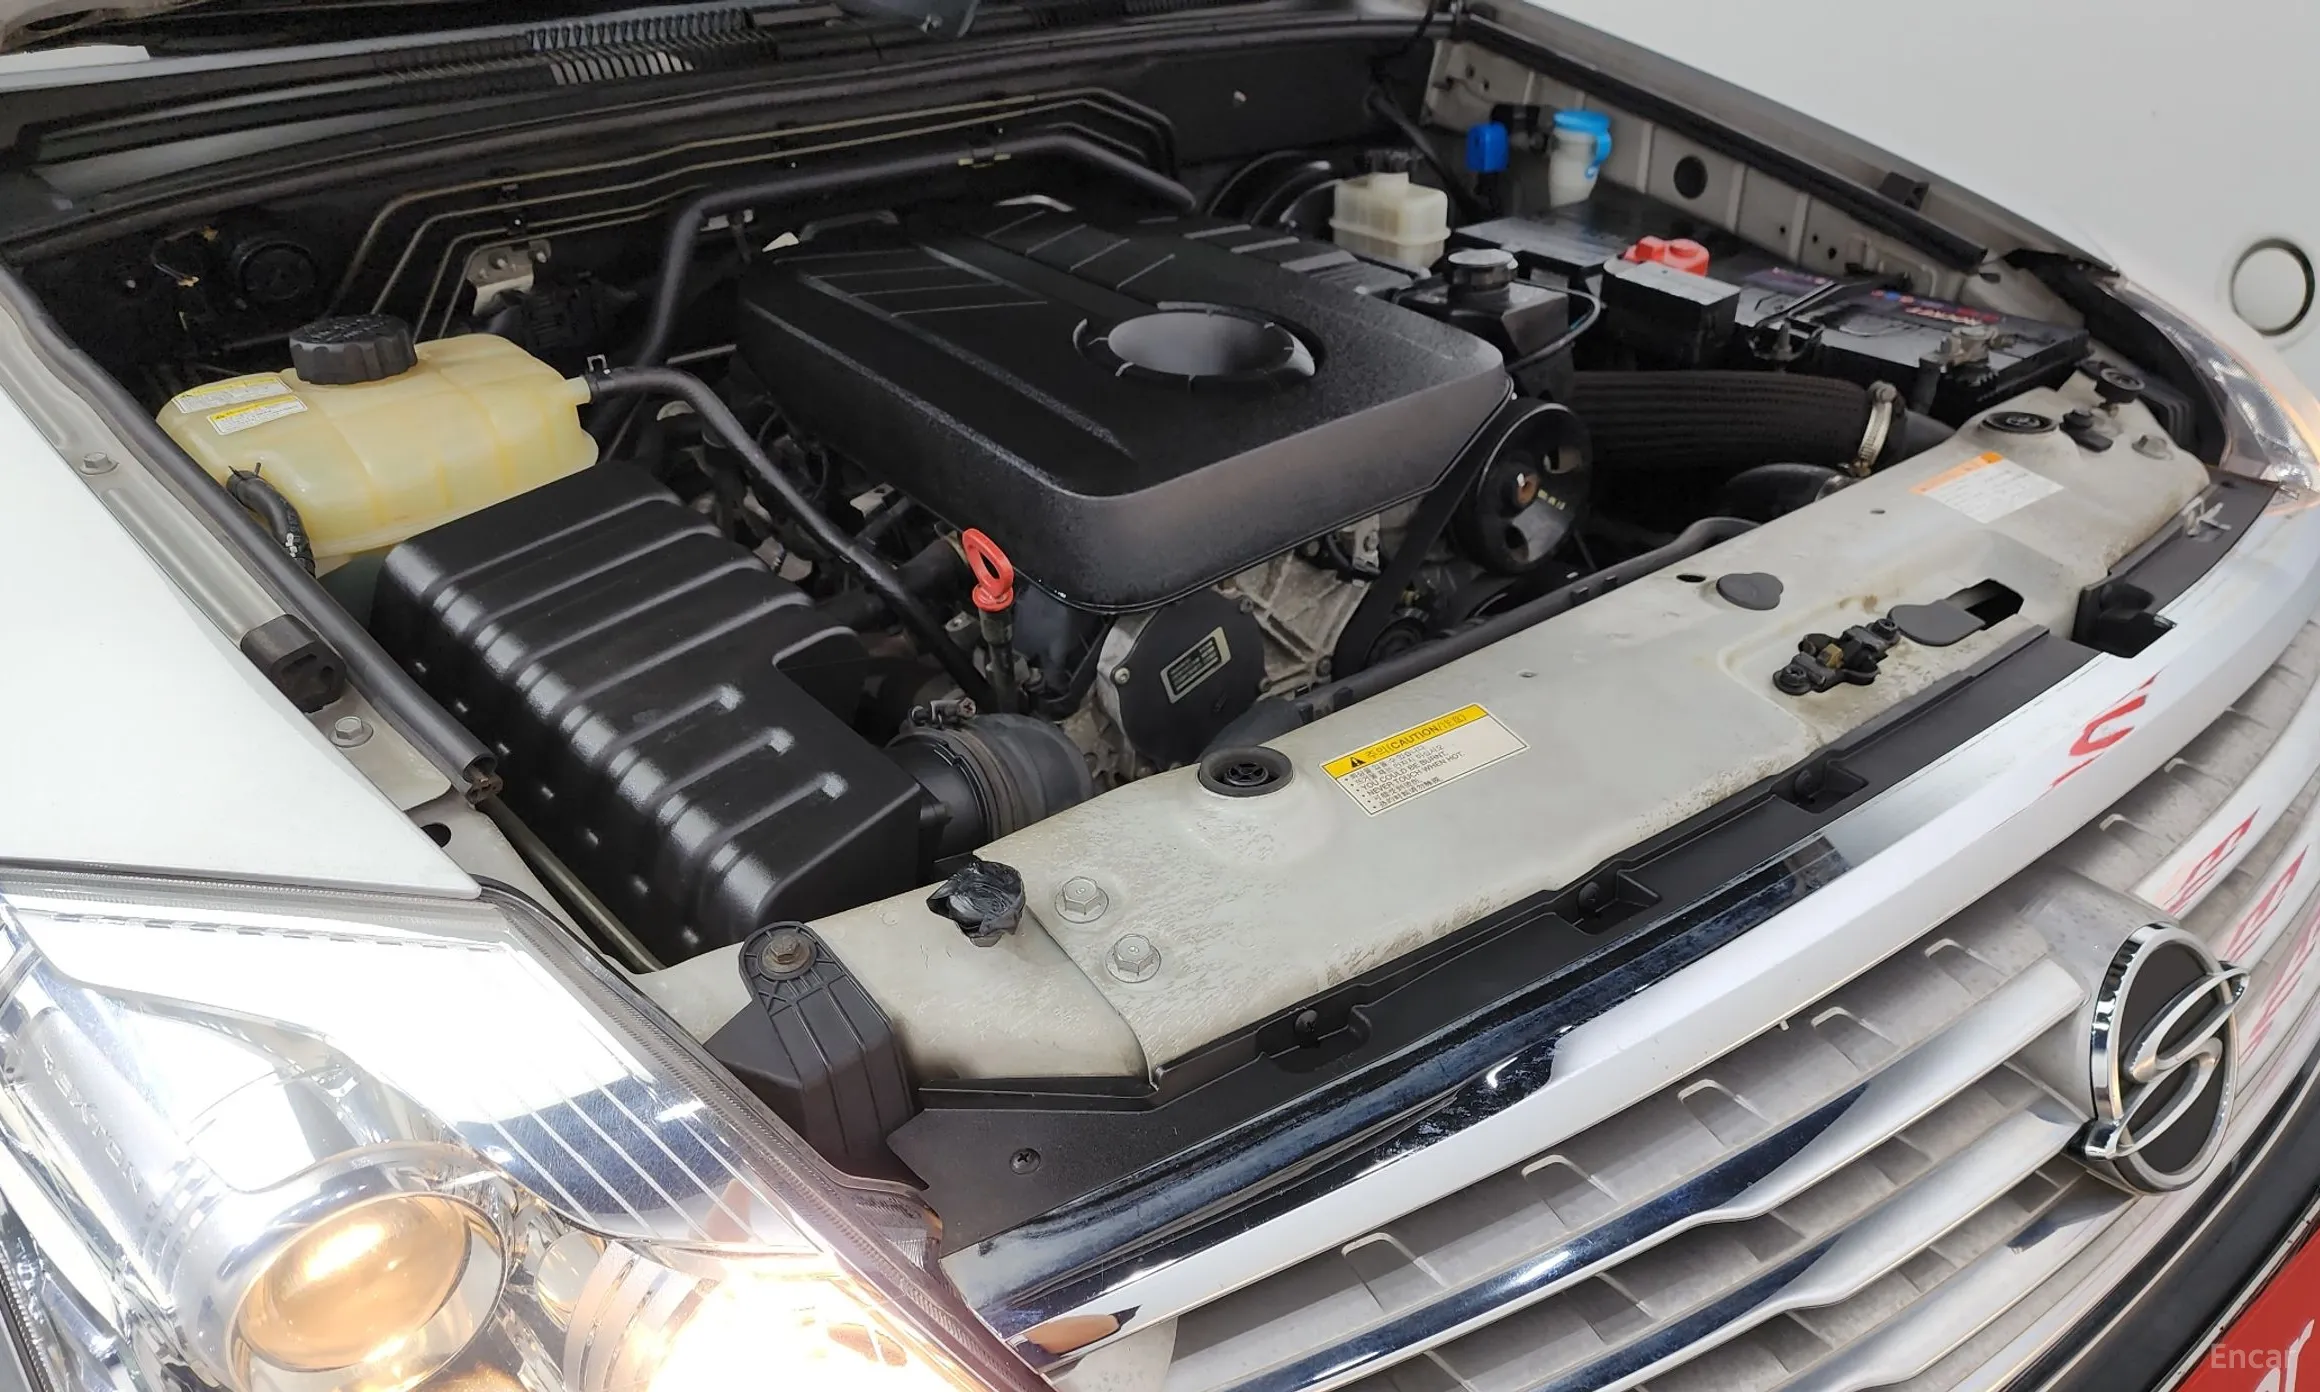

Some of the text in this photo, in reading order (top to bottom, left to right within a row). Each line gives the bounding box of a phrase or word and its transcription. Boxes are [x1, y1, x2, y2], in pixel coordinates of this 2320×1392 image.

[1361, 779, 1380, 790] YOU
[1379, 767, 1407, 782] COULD
[1407, 762, 1420, 770] BE
[1366, 781, 1395, 796] NEVER
[1393, 769, 1422, 784] TOUCH
[1422, 759, 1447, 772] WHEN
